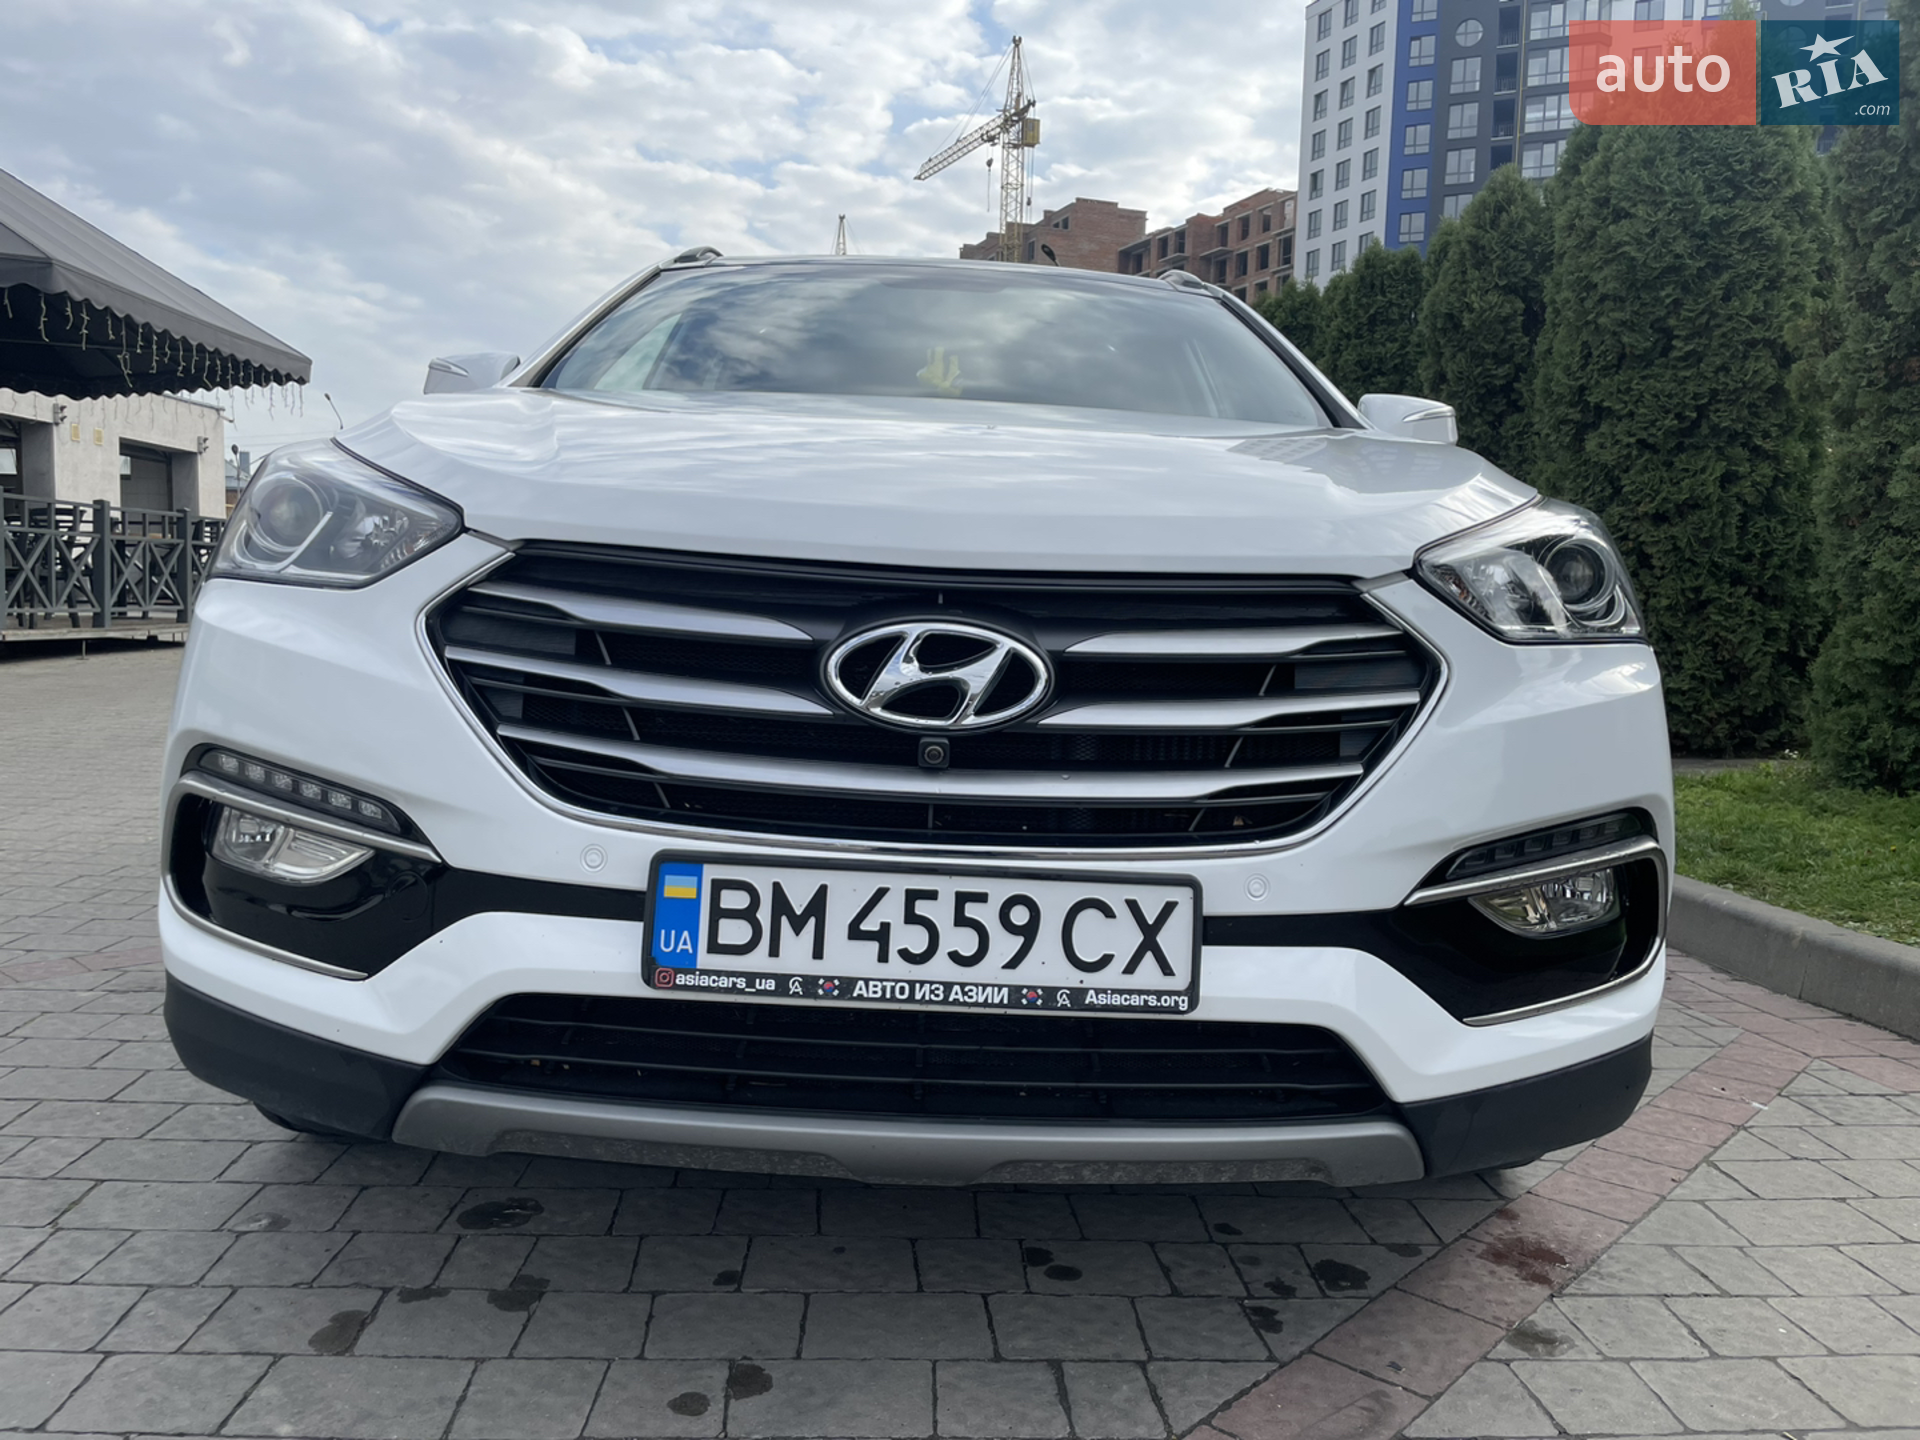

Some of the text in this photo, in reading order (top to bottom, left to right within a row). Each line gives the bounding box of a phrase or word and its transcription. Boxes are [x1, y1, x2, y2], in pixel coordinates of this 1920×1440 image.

[706, 878, 1180, 977] BM 4559 CX
[659, 929, 693, 954] UA
[675, 971, 776, 992] asiacars_ua
[852, 980, 1009, 1005] АВТО ИЗ АЗИИ
[1084, 989, 1189, 1011] Asiacars.org
